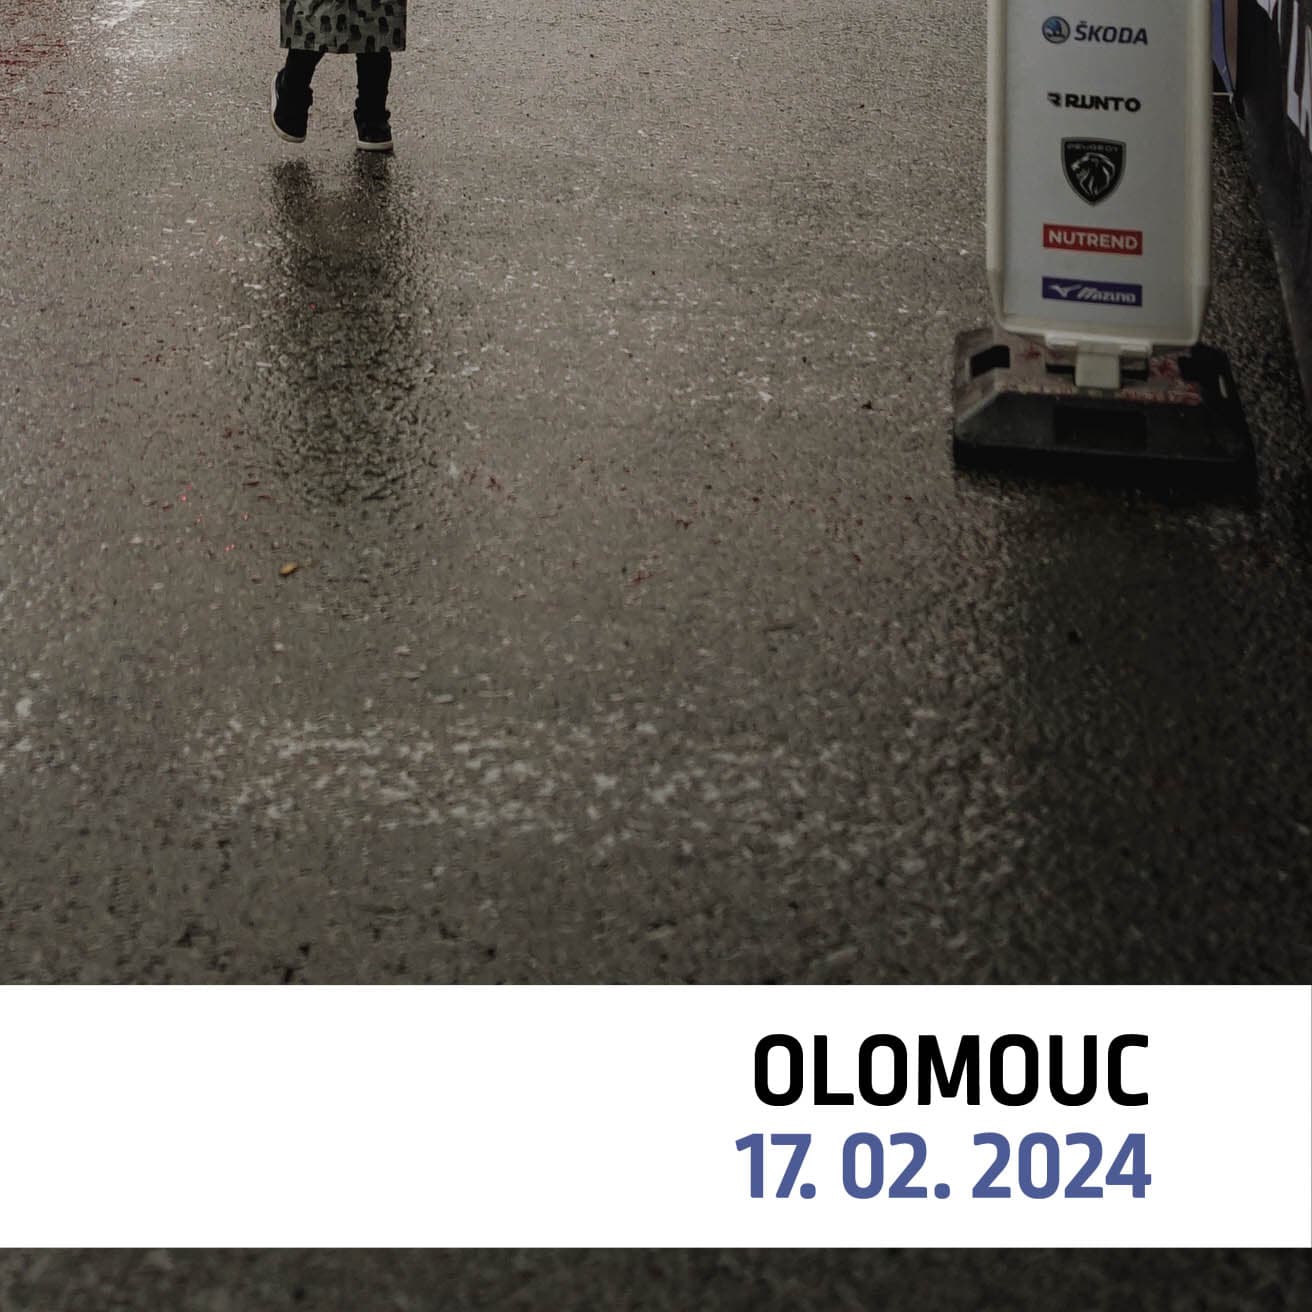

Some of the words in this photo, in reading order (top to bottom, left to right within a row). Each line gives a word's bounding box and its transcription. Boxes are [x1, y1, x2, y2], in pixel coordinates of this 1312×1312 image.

[1074, 20, 1149, 45] ŠKODA
[1064, 92, 1141, 113] RUNTO
[1048, 229, 1139, 251] NUTREND
